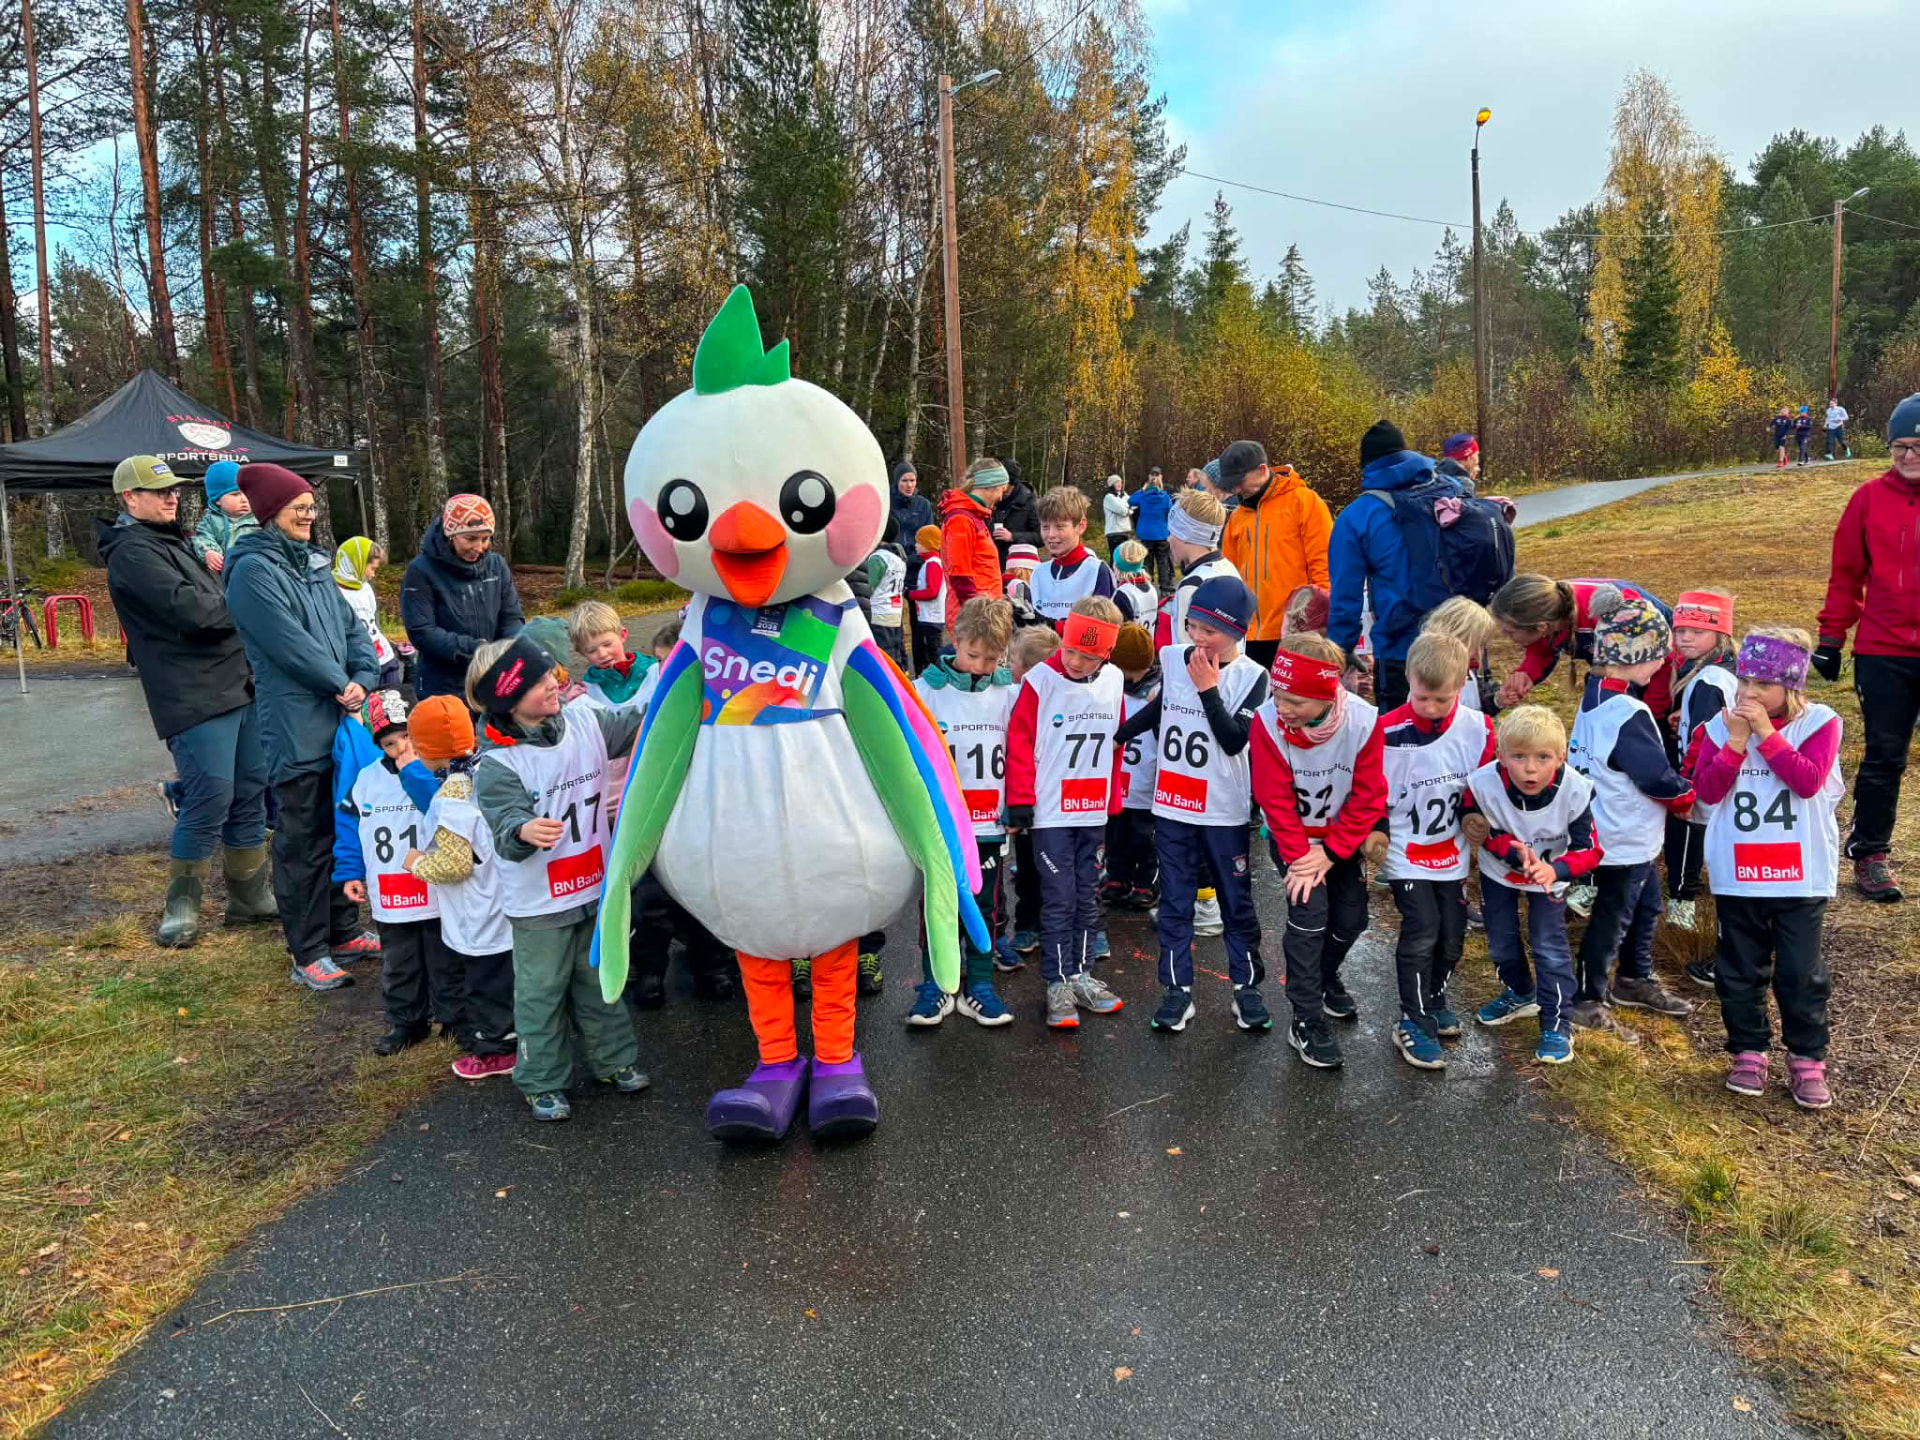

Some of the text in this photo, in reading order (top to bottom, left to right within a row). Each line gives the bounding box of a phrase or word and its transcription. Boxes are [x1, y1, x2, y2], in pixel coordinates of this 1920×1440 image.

[704, 646, 819, 697] Snedi
[1065, 732, 1106, 769] 77
[1164, 725, 1210, 769] 66
[1063, 796, 1105, 810] BN Bank
[1173, 794, 1203, 811] Bank
[1406, 791, 1460, 836] 123
[1733, 788, 1798, 832] 84
[373, 825, 418, 864] 81
[553, 868, 604, 895] BN Bank
[1738, 865, 1800, 879] BN Bank
[393, 893, 426, 906] Bank
